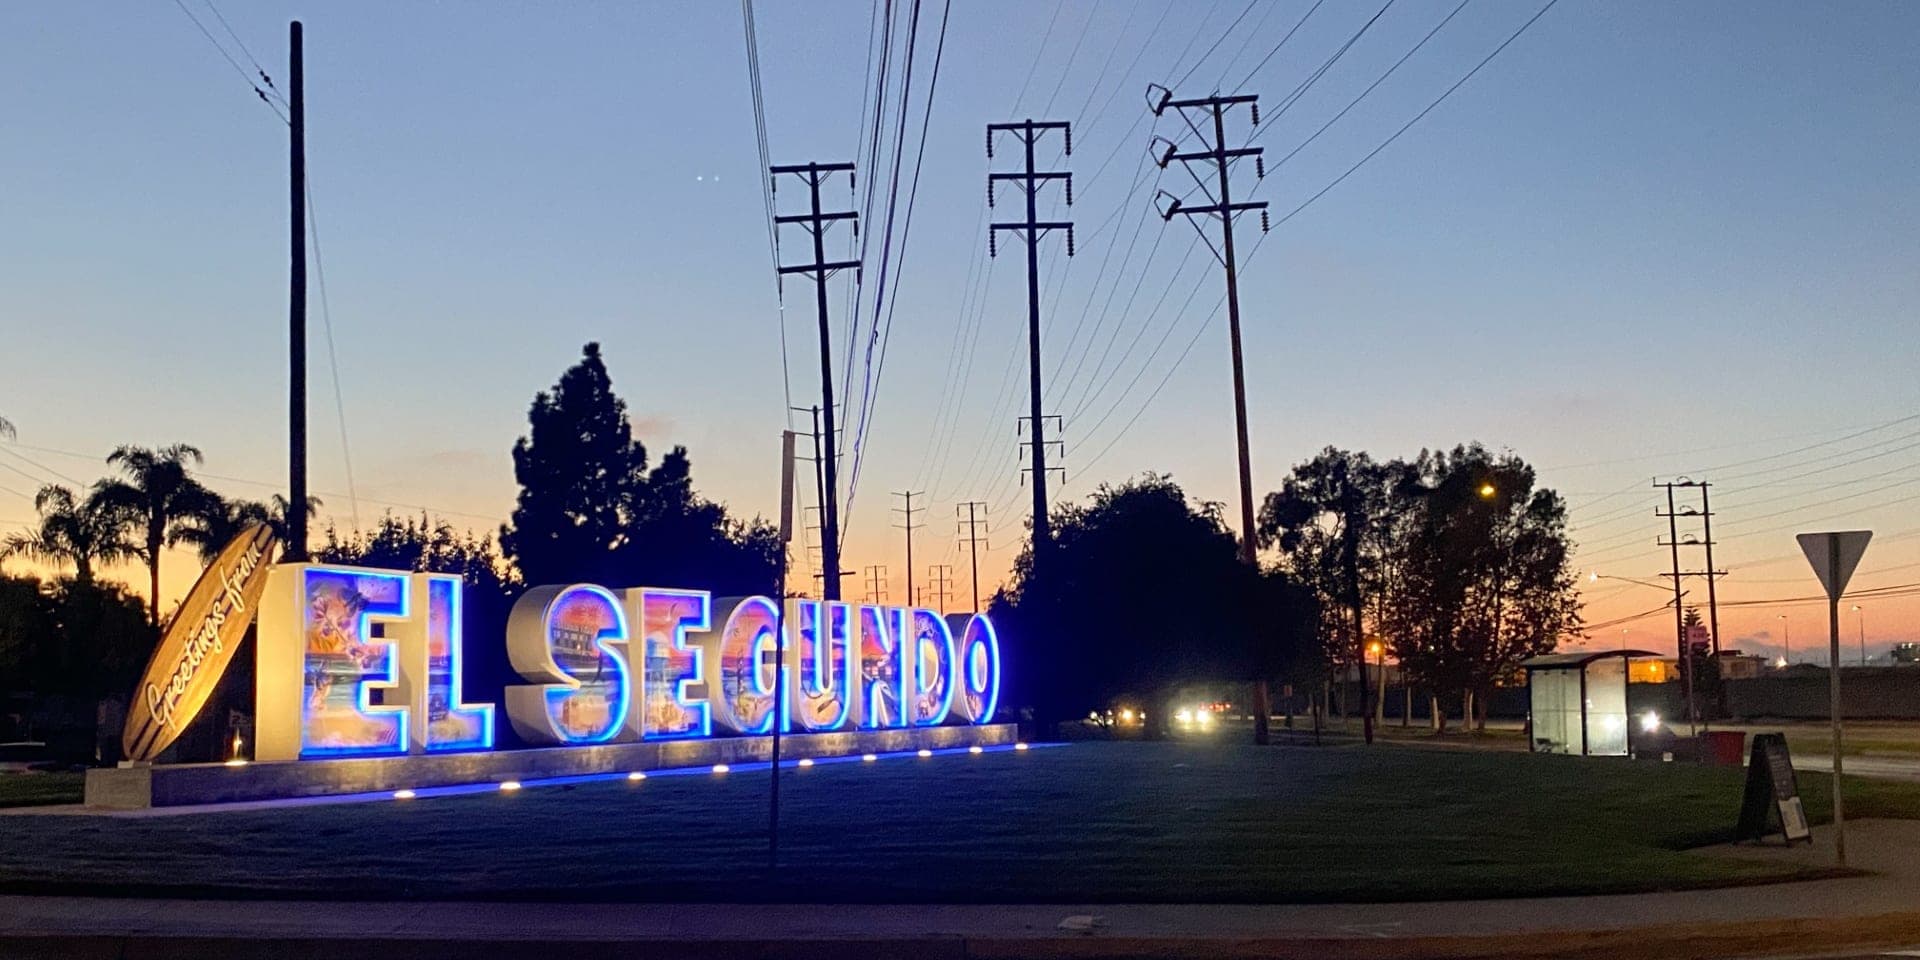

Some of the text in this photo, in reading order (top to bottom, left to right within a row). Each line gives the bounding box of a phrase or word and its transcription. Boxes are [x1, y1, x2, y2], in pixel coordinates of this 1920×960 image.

[147, 541, 263, 728] Greetings from
[260, 563, 1001, 760] EL SEGUNDO
